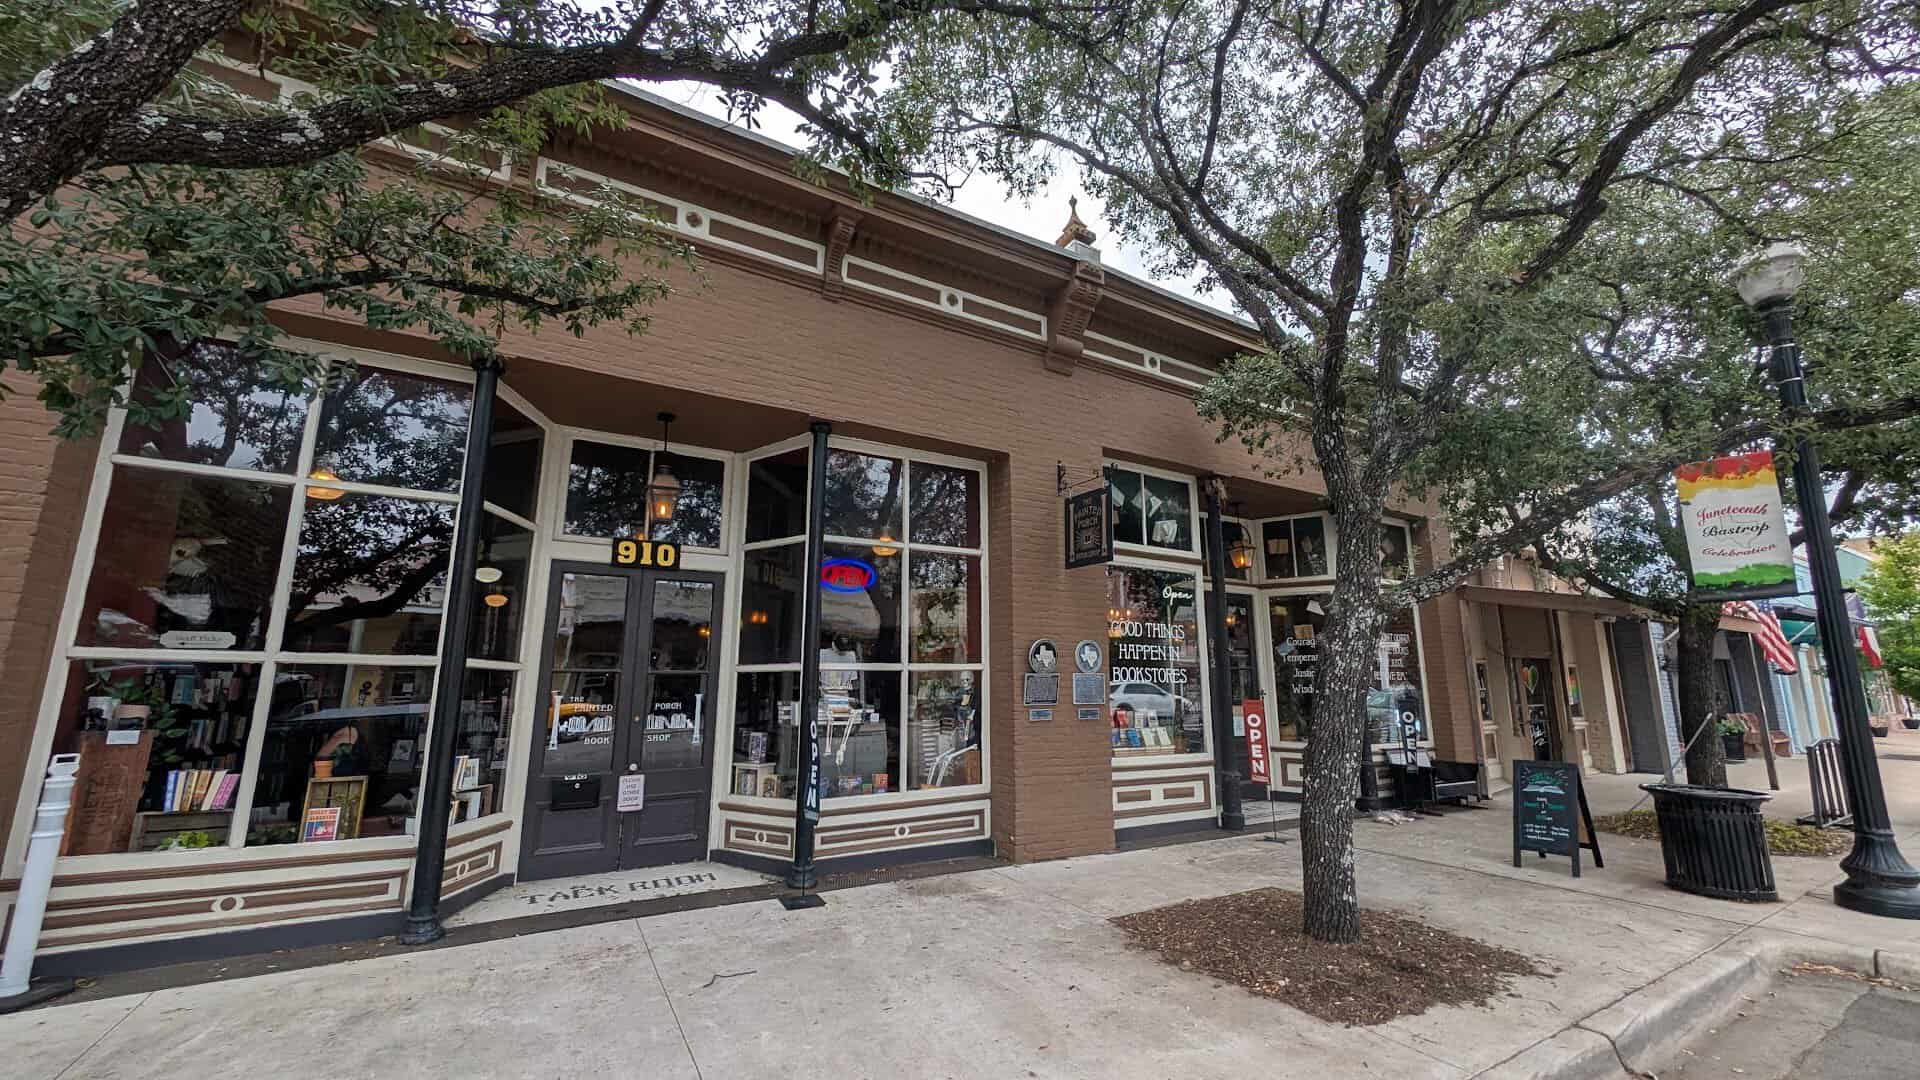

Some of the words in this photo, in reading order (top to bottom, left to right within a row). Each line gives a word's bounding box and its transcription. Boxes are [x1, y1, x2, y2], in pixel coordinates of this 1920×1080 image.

[1697, 503, 1768, 526] Juneteenth
[1702, 521, 1769, 537] Bastrop
[617, 541, 675, 567] 910
[1702, 543, 1776, 557] Celebration
[822, 566, 870, 587] OPEN
[1162, 586, 1193, 606] Open
[1111, 620, 1142, 638] GOOD
[1145, 622, 1185, 639] THINGS
[1286, 636, 1316, 649] Courag
[1119, 643, 1167, 660] HAPPEN
[1169, 646, 1180, 661] IN
[1112, 666, 1187, 684] BOOKSTORES
[1293, 668, 1316, 678] Justic
[1291, 683, 1314, 694] Wisd
[569, 695, 585, 703] THE
[574, 703, 613, 713] PAINTED
[655, 702, 682, 711] PORCH
[584, 736, 610, 745] BOOK
[647, 733, 672, 742] SHOP
[1246, 713, 1265, 774] OPEN
[1402, 711, 1417, 764] OPEN
[806, 720, 818, 809] OPEN
[520, 884, 619, 906] TACK
[628, 872, 717, 892] ROOM
